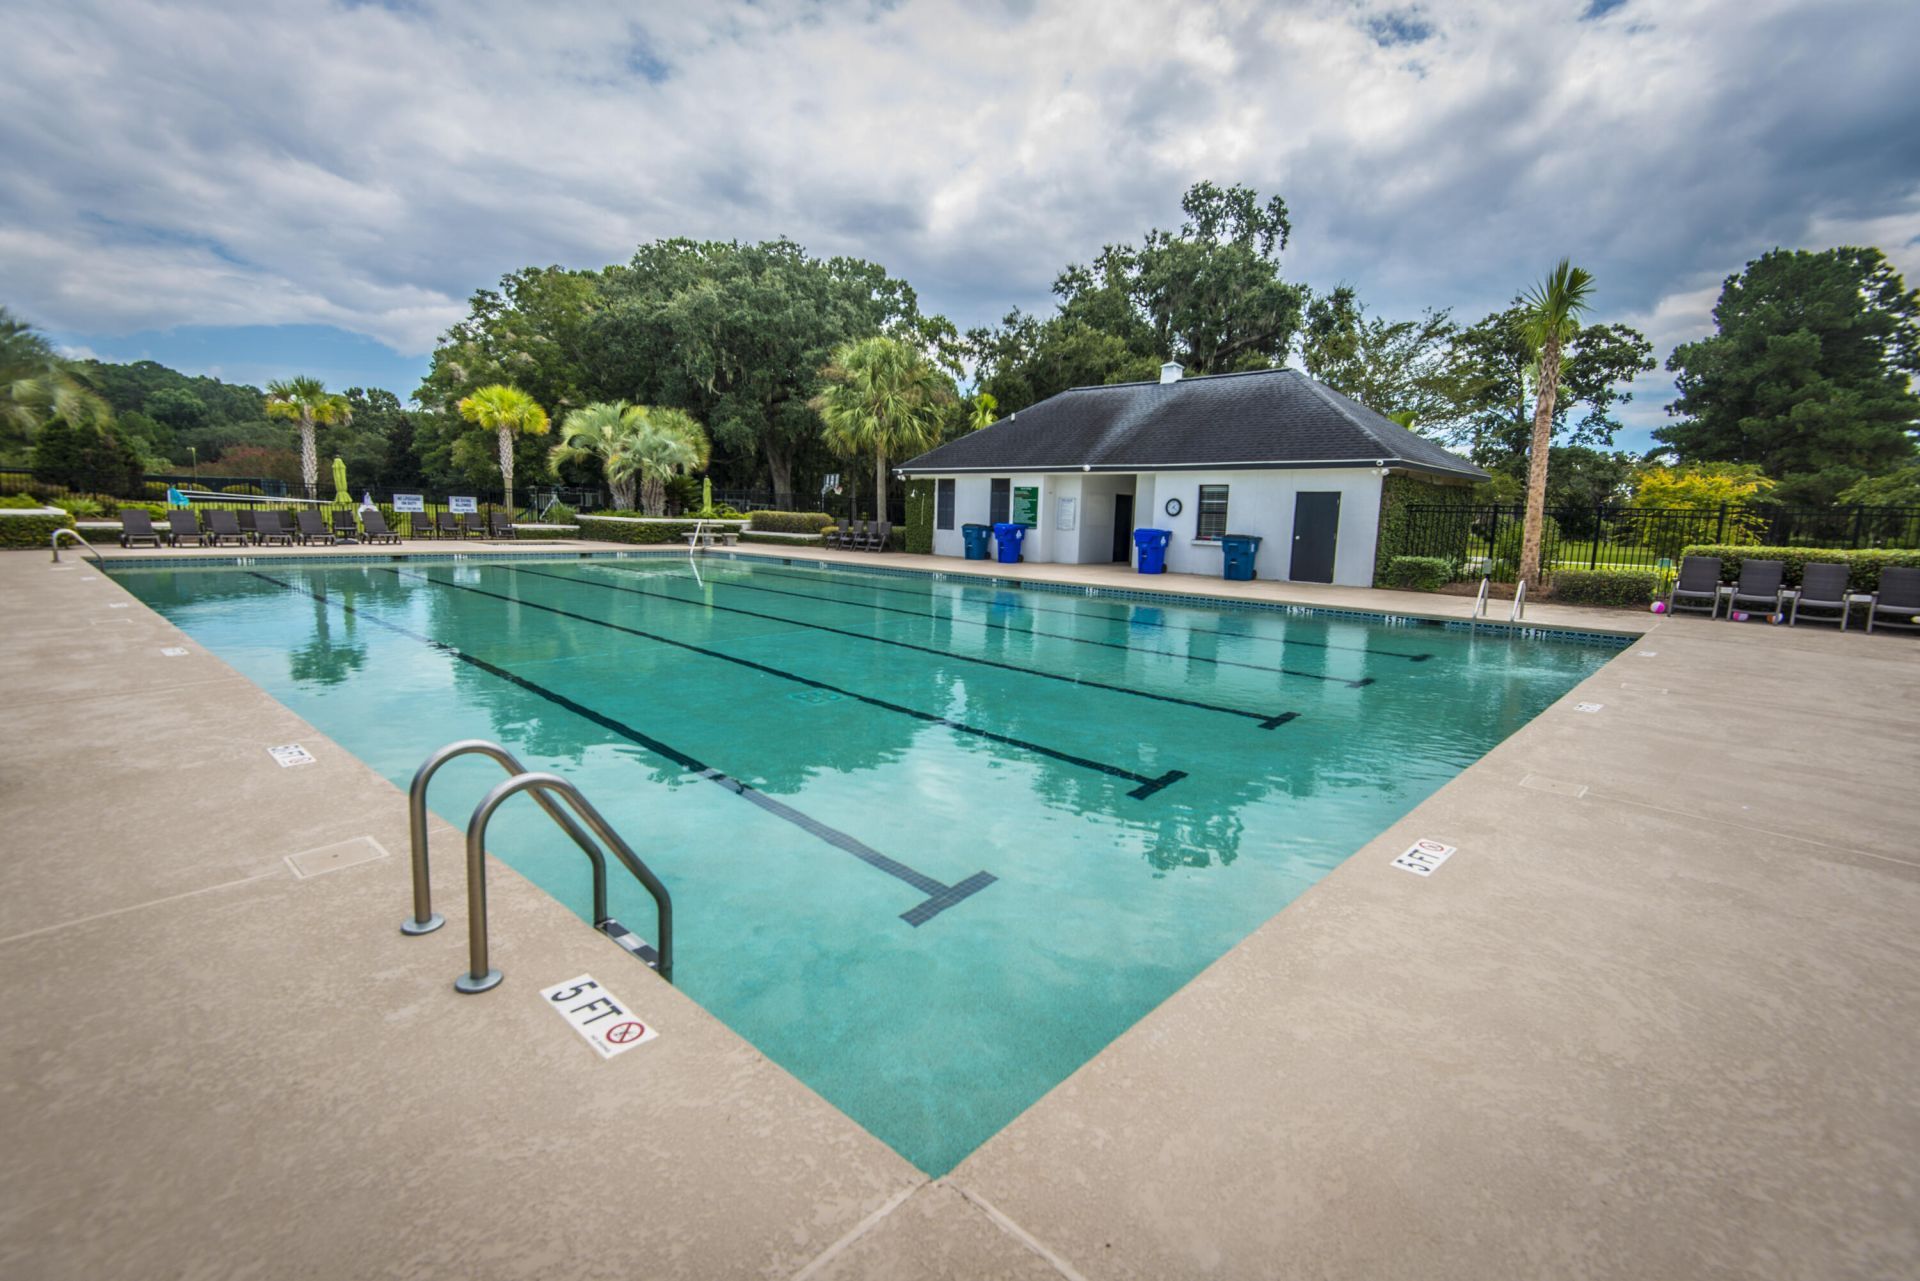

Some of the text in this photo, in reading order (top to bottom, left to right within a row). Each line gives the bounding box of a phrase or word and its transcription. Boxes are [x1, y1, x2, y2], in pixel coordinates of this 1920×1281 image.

[1534, 629, 1546, 640] FT
[550, 980, 623, 1026] 5 FT
